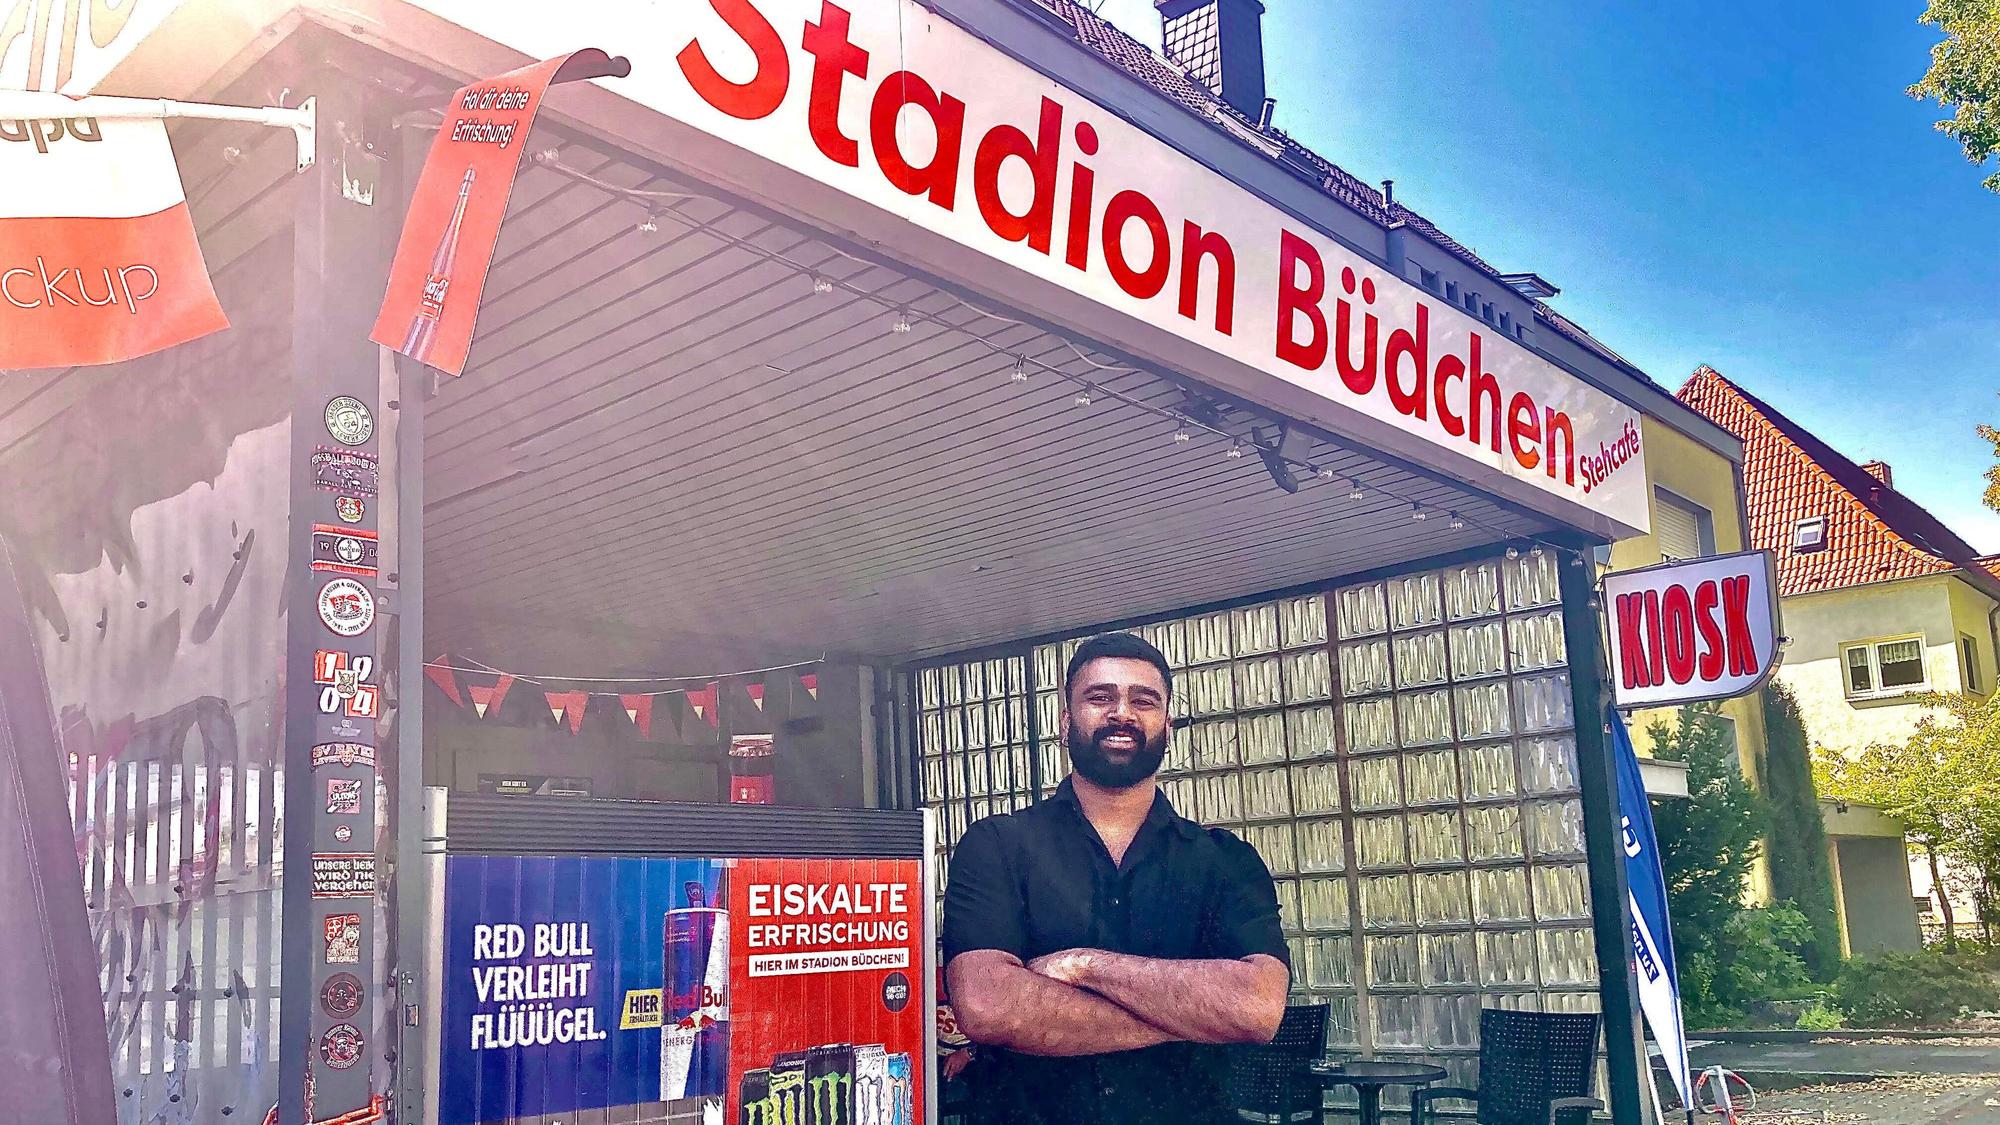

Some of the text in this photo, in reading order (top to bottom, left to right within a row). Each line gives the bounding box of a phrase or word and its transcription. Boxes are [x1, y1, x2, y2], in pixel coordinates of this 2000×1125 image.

[461, 87, 530, 110] Hol dir deine
[451, 119, 518, 148] Erfrischung!
[675, 0, 1575, 487] Stadion Büdchen
[1579, 417, 1640, 495] Stehcafé
[1615, 573, 1758, 689] KIOSK
[749, 883, 908, 917] EISKALTE
[474, 922, 593, 960] RED BULL
[749, 921, 909, 947] ERFRISCHUNG
[754, 952, 905, 972] HIER IM STADION BÜDCHEN!
[472, 962, 591, 1002] VERLEIHT
[701, 985, 728, 1008] Bull
[629, 994, 659, 1014] HIER
[470, 1003, 607, 1050] FLÜÜÜGEL.
